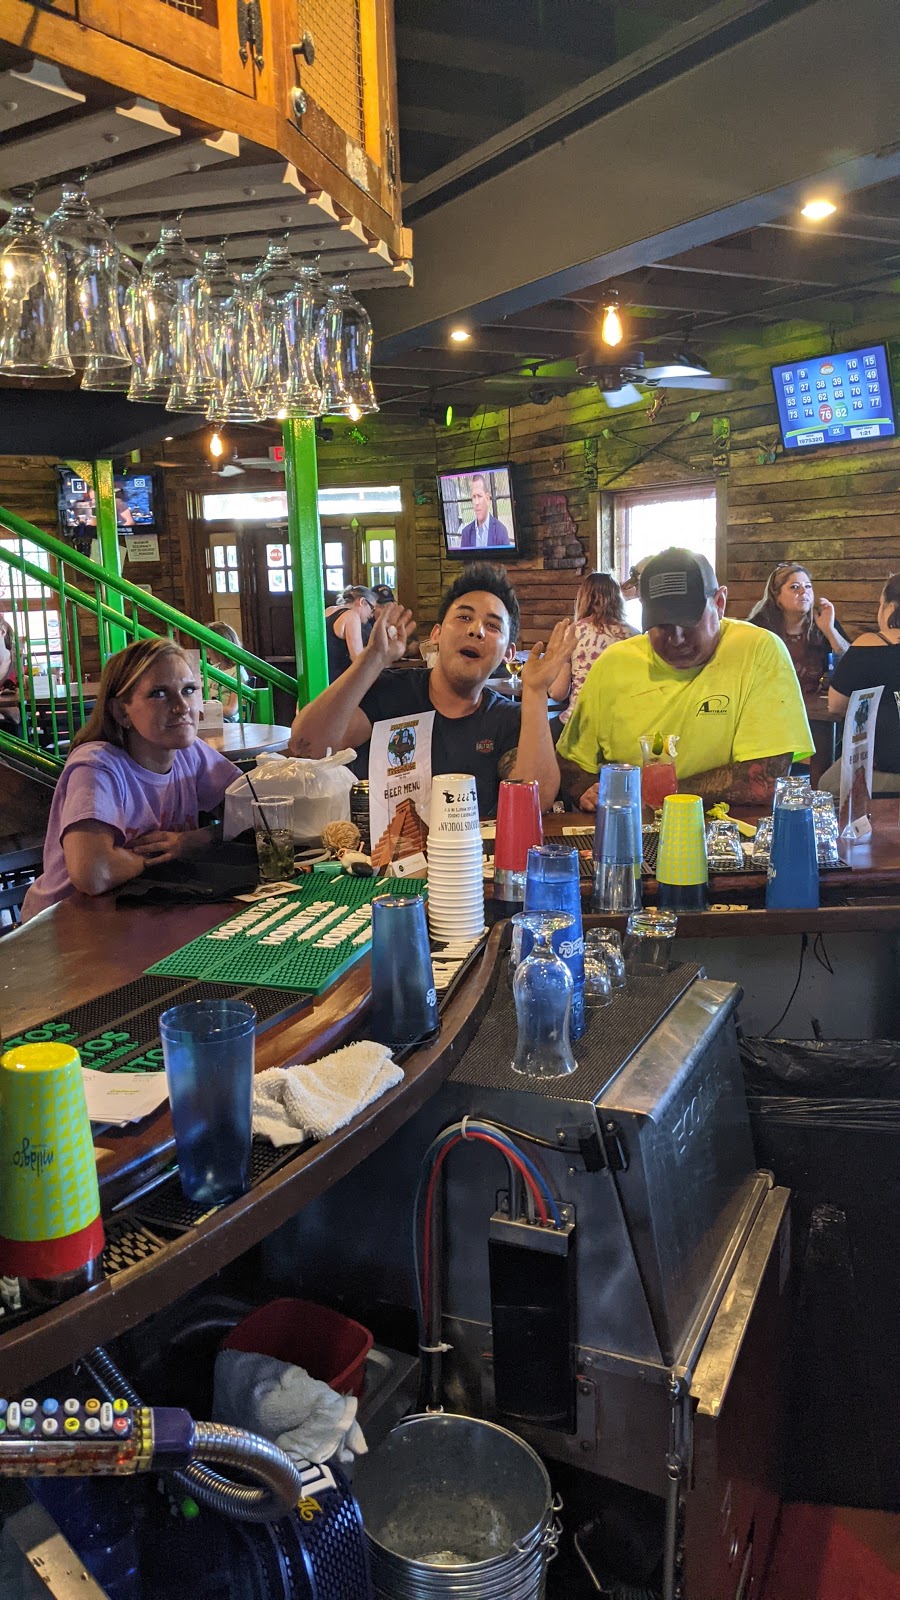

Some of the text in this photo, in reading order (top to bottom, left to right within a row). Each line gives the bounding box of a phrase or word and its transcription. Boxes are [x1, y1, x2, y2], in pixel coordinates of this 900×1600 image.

[785, 373, 790, 381] 8
[847, 361, 857, 369] 10
[865, 357, 874, 366] 15
[800, 383, 809, 391] 27
[816, 380, 825, 389] 38
[832, 377, 842, 386] 39
[849, 374, 859, 383] 46
[866, 370, 877, 379] 49
[787, 398, 796, 406] 53
[802, 396, 811, 404] 59
[818, 393, 828, 401] 62
[851, 387, 861, 396] 70
[868, 384, 878, 393] 72
[871, 397, 880, 406] 77
[789, 411, 798, 419] 73
[804, 408, 813, 416] 74
[820, 410, 832, 422] 76
[835, 408, 847, 418] 62
[384, 779, 421, 800] BEER MENU
[206, 897, 289, 941] HORNITOS
[257, 900, 336, 946] HORNITOS
[87, 1400, 98, 1409] O
